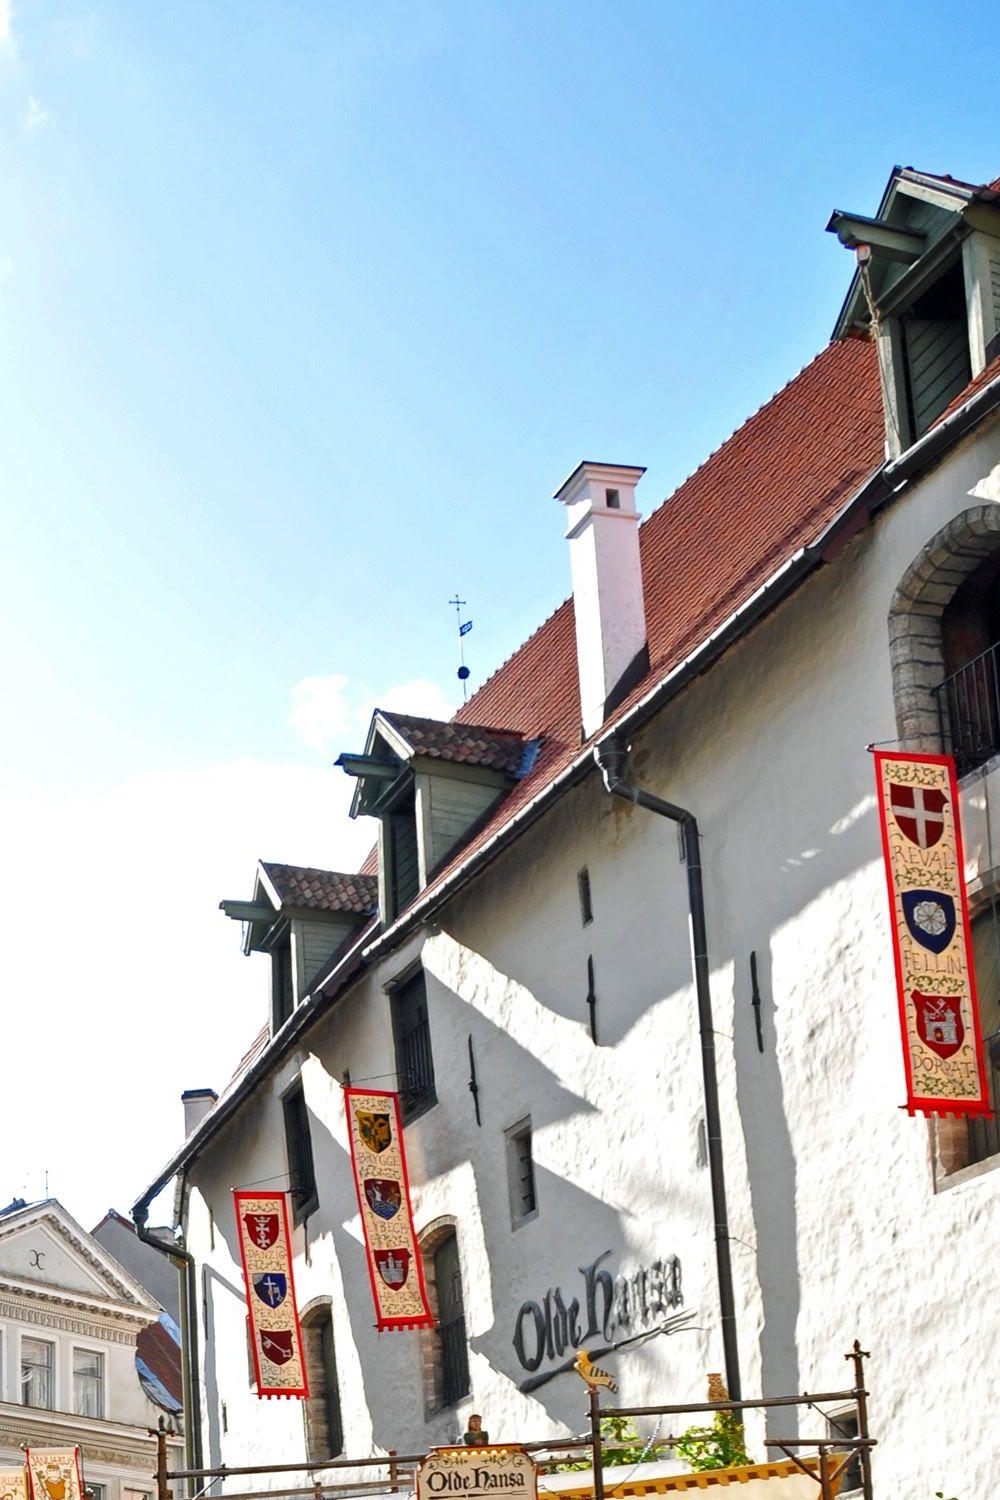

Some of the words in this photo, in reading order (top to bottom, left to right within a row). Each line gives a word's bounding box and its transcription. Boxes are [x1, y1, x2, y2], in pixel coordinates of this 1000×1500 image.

[892, 845, 955, 870] REVAL
[903, 949, 962, 976] FELLIN
[912, 1053, 973, 1079] DORPAT
[357, 1151, 400, 1168] BRYGGE
[249, 1249, 286, 1261] DANZIG
[512, 1286, 581, 1372] Olde
[262, 1364, 301, 1377] BREMEN
[426, 1470, 470, 1492] Olde
